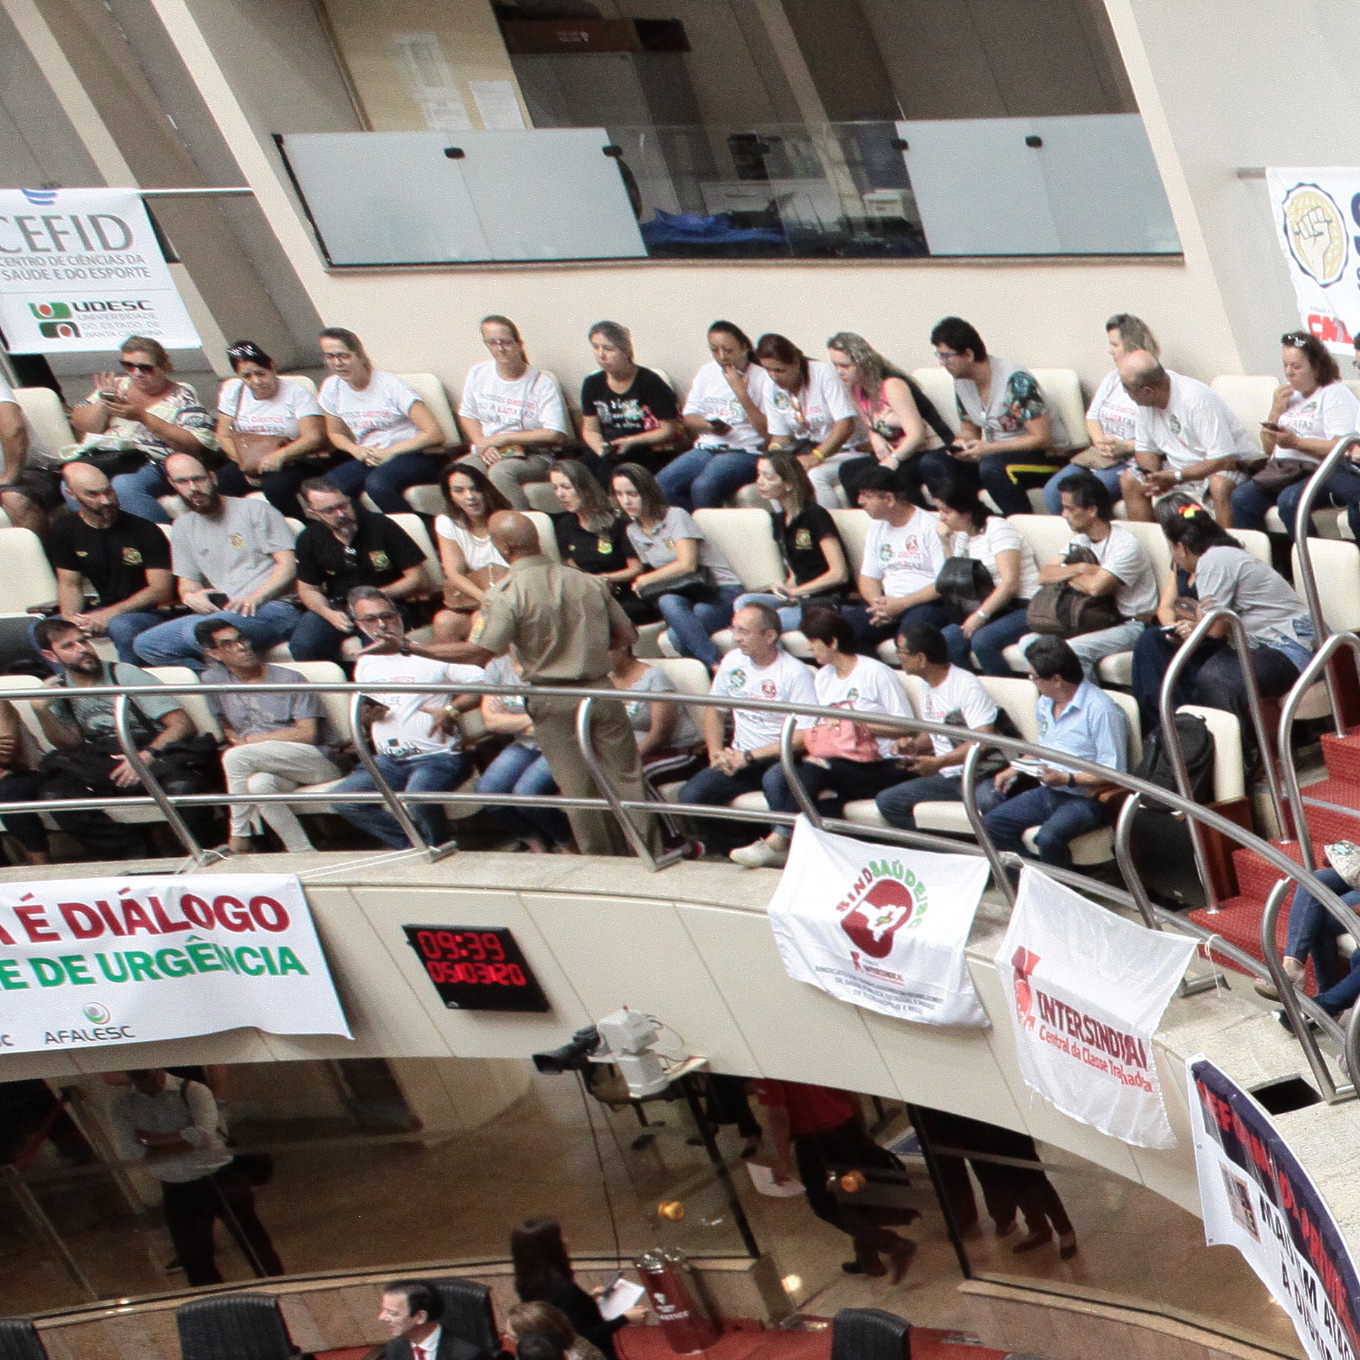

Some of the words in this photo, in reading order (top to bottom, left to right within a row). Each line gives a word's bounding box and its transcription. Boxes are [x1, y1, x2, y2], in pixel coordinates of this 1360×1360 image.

[50, 254, 67, 266] DE
[127, 253, 146, 265] DA
[55, 267, 66, 280] E
[65, 266, 87, 280] DO
[90, 265, 152, 279] ESPORTE
[72, 299, 154, 313] UDESC
[12, 892, 62, 943] É
[58, 887, 291, 940] DIÁLOGO
[417, 930, 506, 961] 09:39
[0, 959, 31, 990] E
[28, 955, 97, 988] DE
[94, 935, 311, 984] URGÊNCIA
[44, 1025, 136, 1045] AFALESC
[1040, 1025, 1071, 1055] Central
[1071, 1041, 1082, 1061] da
[1083, 1047, 1109, 1073] Classe
